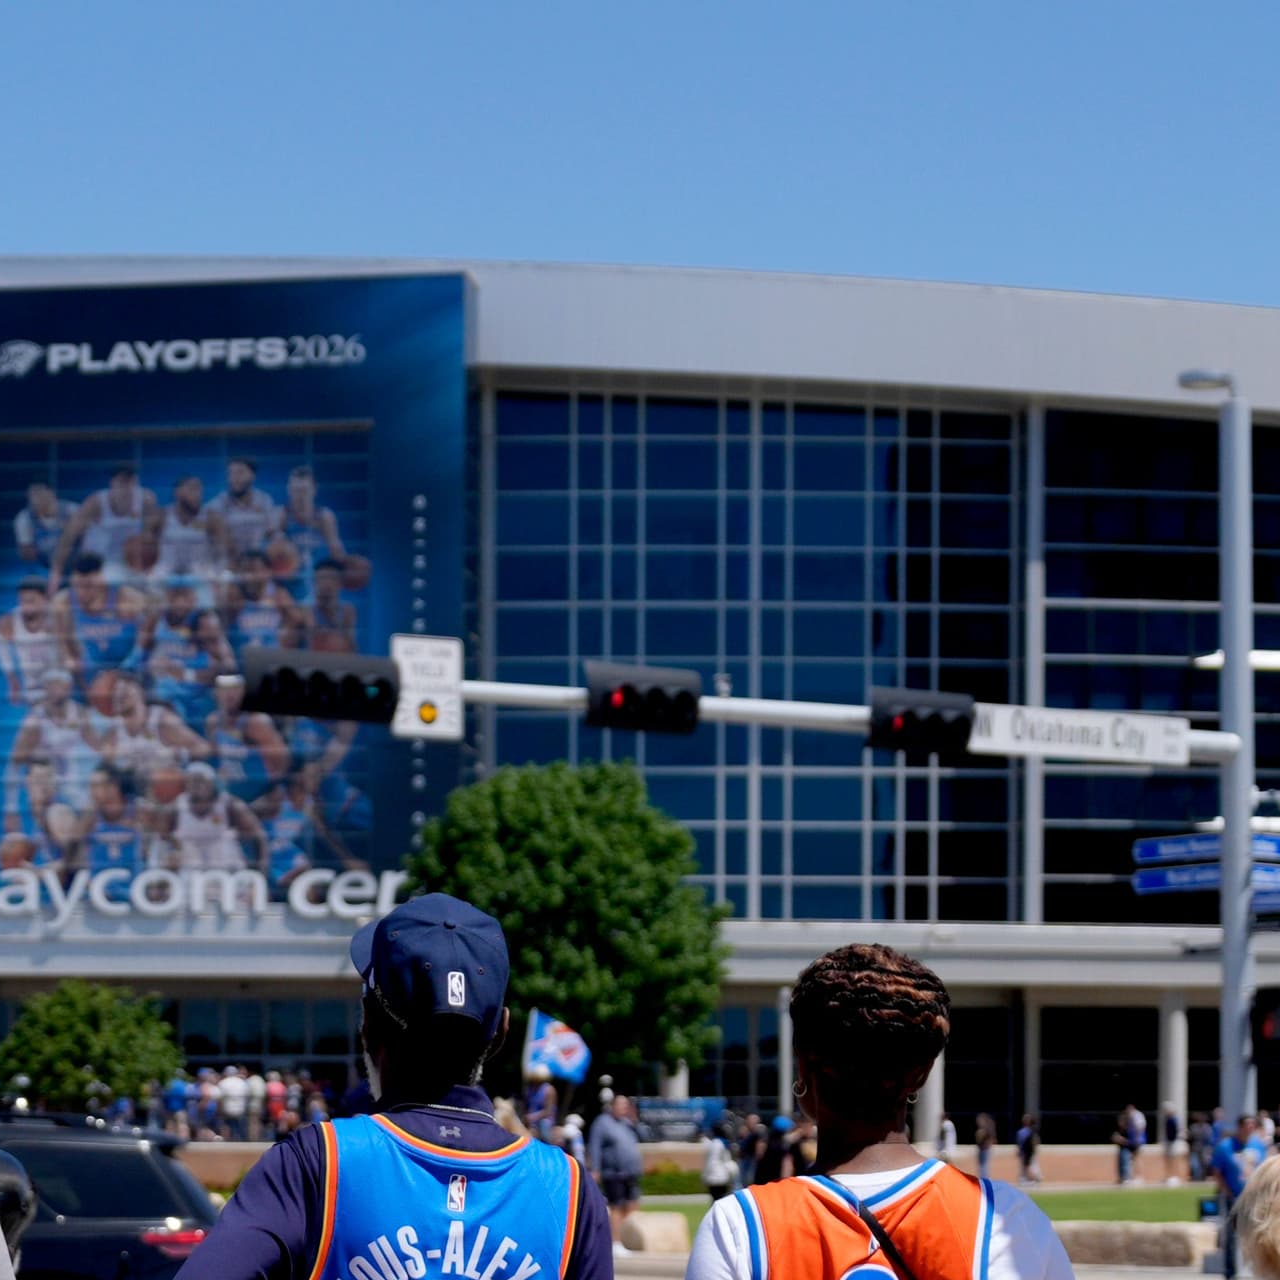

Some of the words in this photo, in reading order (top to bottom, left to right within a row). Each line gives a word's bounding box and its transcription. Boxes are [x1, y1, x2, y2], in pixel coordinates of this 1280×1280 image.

[46, 337, 289, 375] PLAYOFFS
[288, 333, 368, 367] 2026
[1010, 708, 1102, 747] Oklahoma
[1110, 716, 1145, 755] City
